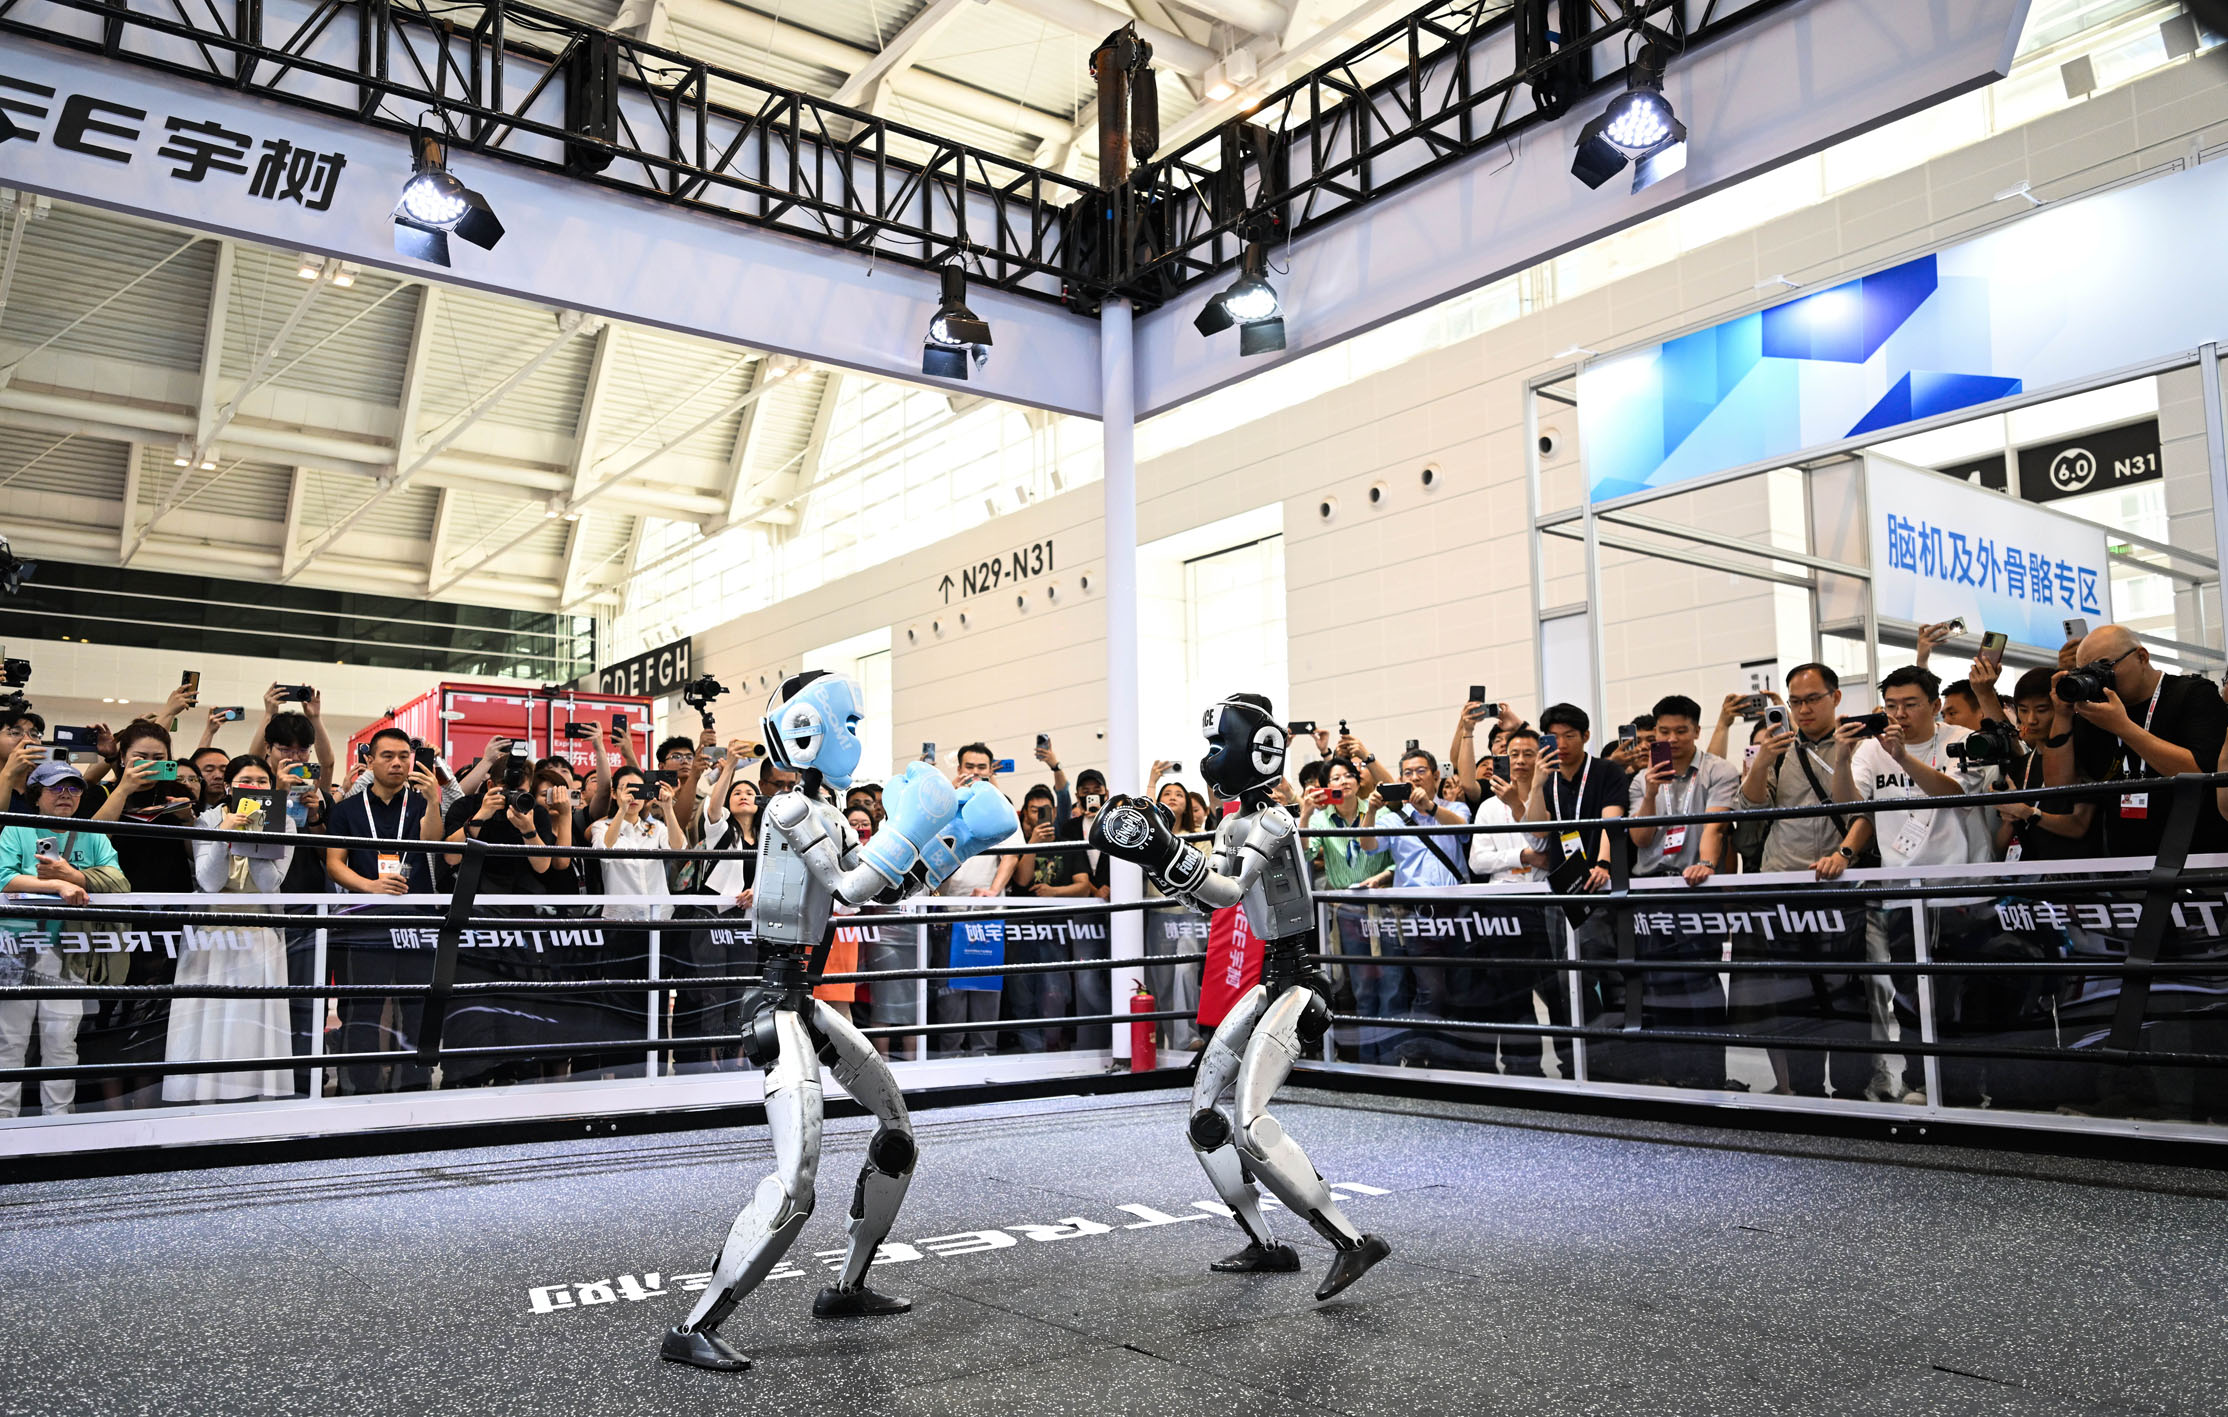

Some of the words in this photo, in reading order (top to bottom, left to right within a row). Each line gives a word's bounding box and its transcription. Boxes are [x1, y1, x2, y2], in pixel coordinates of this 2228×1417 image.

[158, 115, 348, 211] 宇树
[2058, 459, 2089, 481] 6.0
[2114, 453, 2157, 479] N31
[963, 540, 1053, 598] N29-N31
[1887, 513, 2101, 616] 脑机及外骨骼专区
